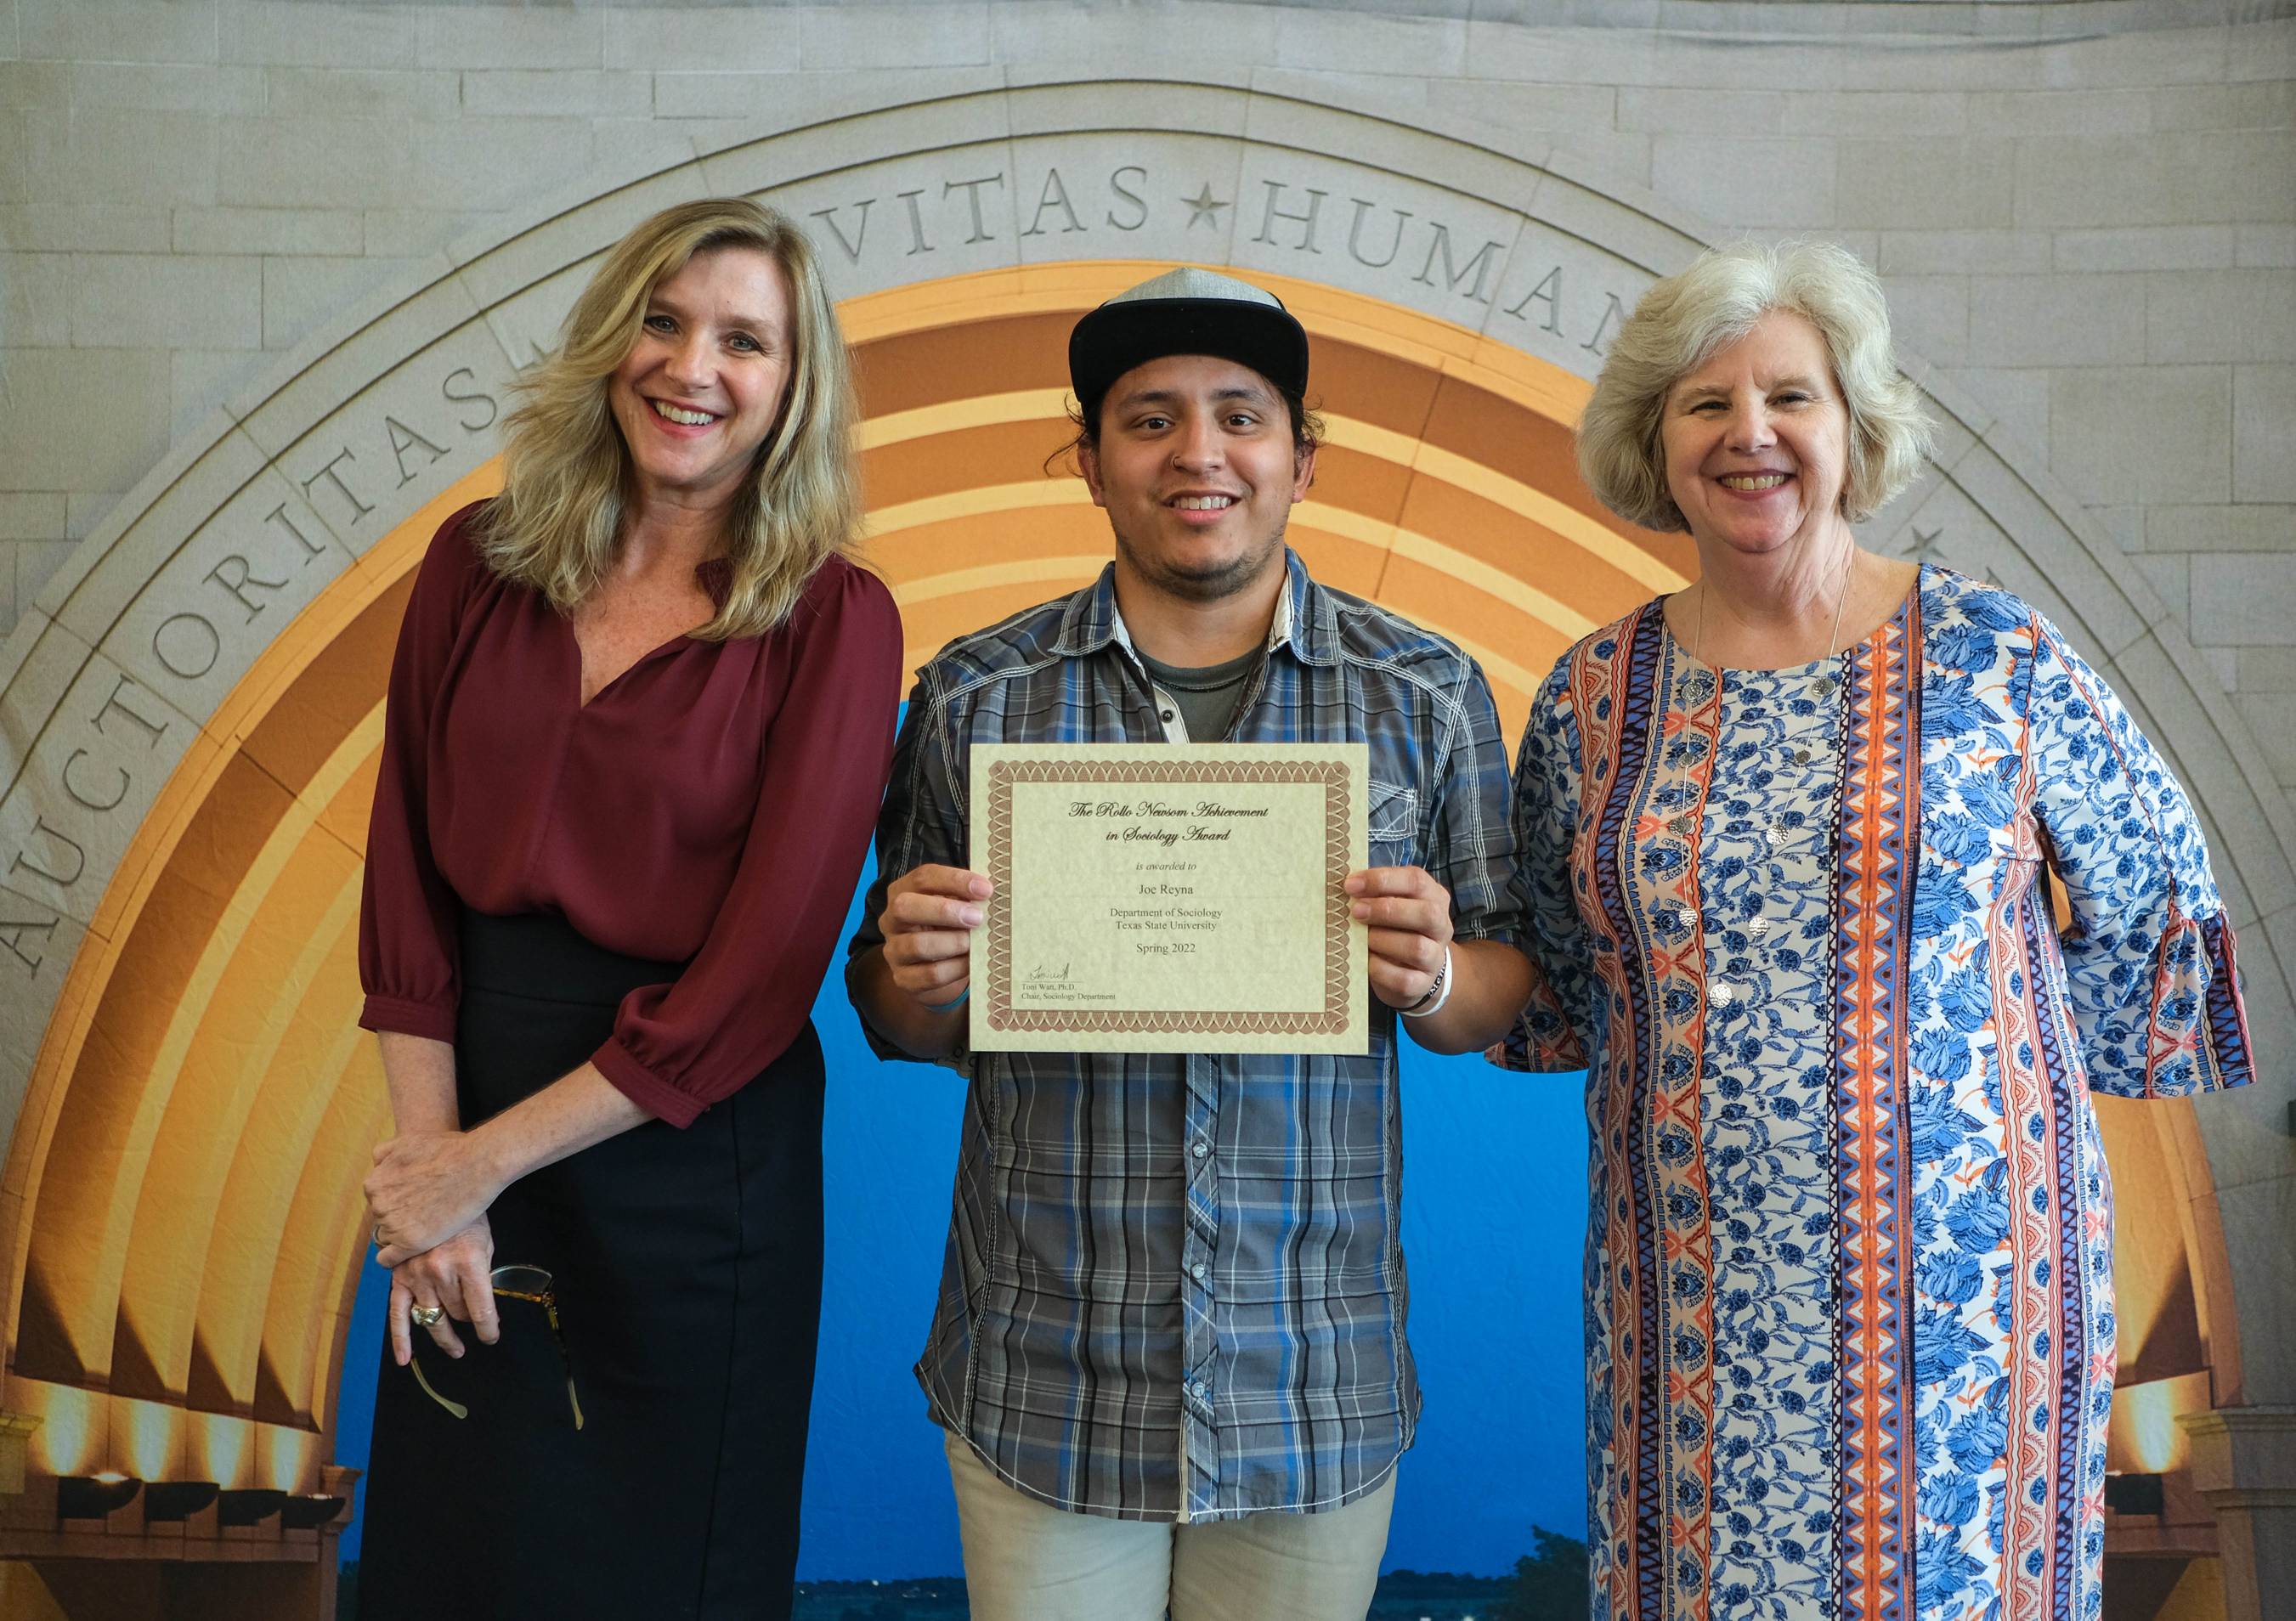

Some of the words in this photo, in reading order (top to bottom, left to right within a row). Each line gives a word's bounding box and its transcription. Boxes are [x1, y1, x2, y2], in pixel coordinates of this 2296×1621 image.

[0, 366, 497, 980] AUCTORITAS
[1068, 802, 1093, 817] The
[1095, 802, 1133, 817] Rollo
[1135, 801, 1189, 817] Newsom
[1191, 801, 1269, 817] Achievement
[1106, 830, 1118, 841] in
[1123, 827, 1179, 847] Sociology
[1182, 825, 1231, 842] Award
[1136, 862, 1144, 871] is
[1145, 861, 1185, 871] awarded
[1188, 862, 1196, 871] to
[1139, 884, 1156, 895] Joe
[1160, 884, 1193, 897] Reyna
[1110, 908, 1162, 918] Department
[1165, 908, 1177, 918] of
[1177, 908, 1223, 920] Sociology
[1116, 921, 1142, 930] Texas
[1145, 921, 1167, 930] State
[1170, 921, 1217, 932] University
[1136, 943, 1168, 956] Spring
[1172, 943, 1196, 953] 2022
